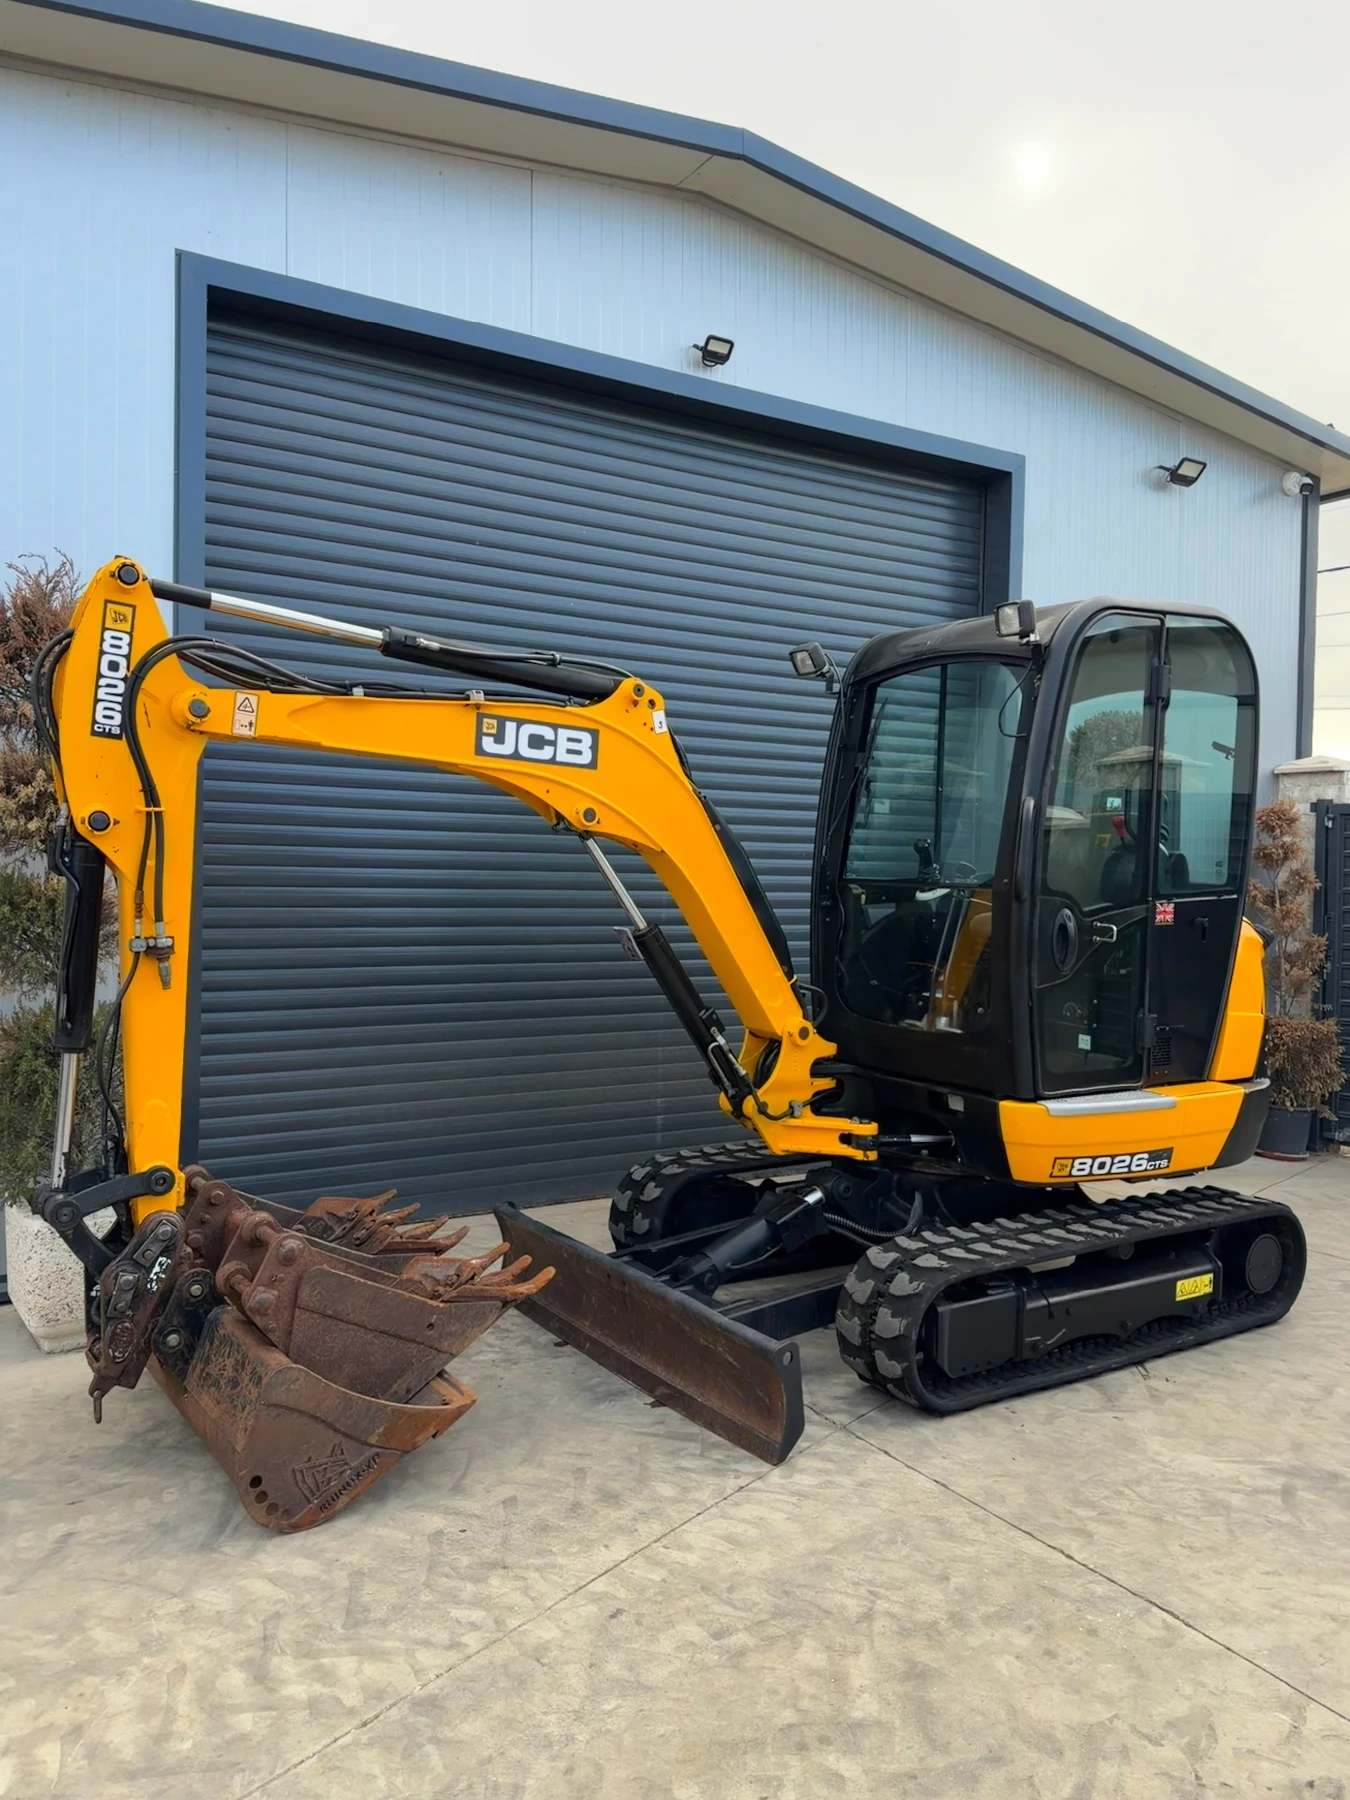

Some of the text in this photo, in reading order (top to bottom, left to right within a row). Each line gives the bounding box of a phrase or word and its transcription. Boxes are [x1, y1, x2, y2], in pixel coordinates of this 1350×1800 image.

[111, 609, 129, 624] JCB
[94, 629, 131, 726] 8026
[94, 723, 121, 735] CTS
[481, 720, 593, 765] JCB
